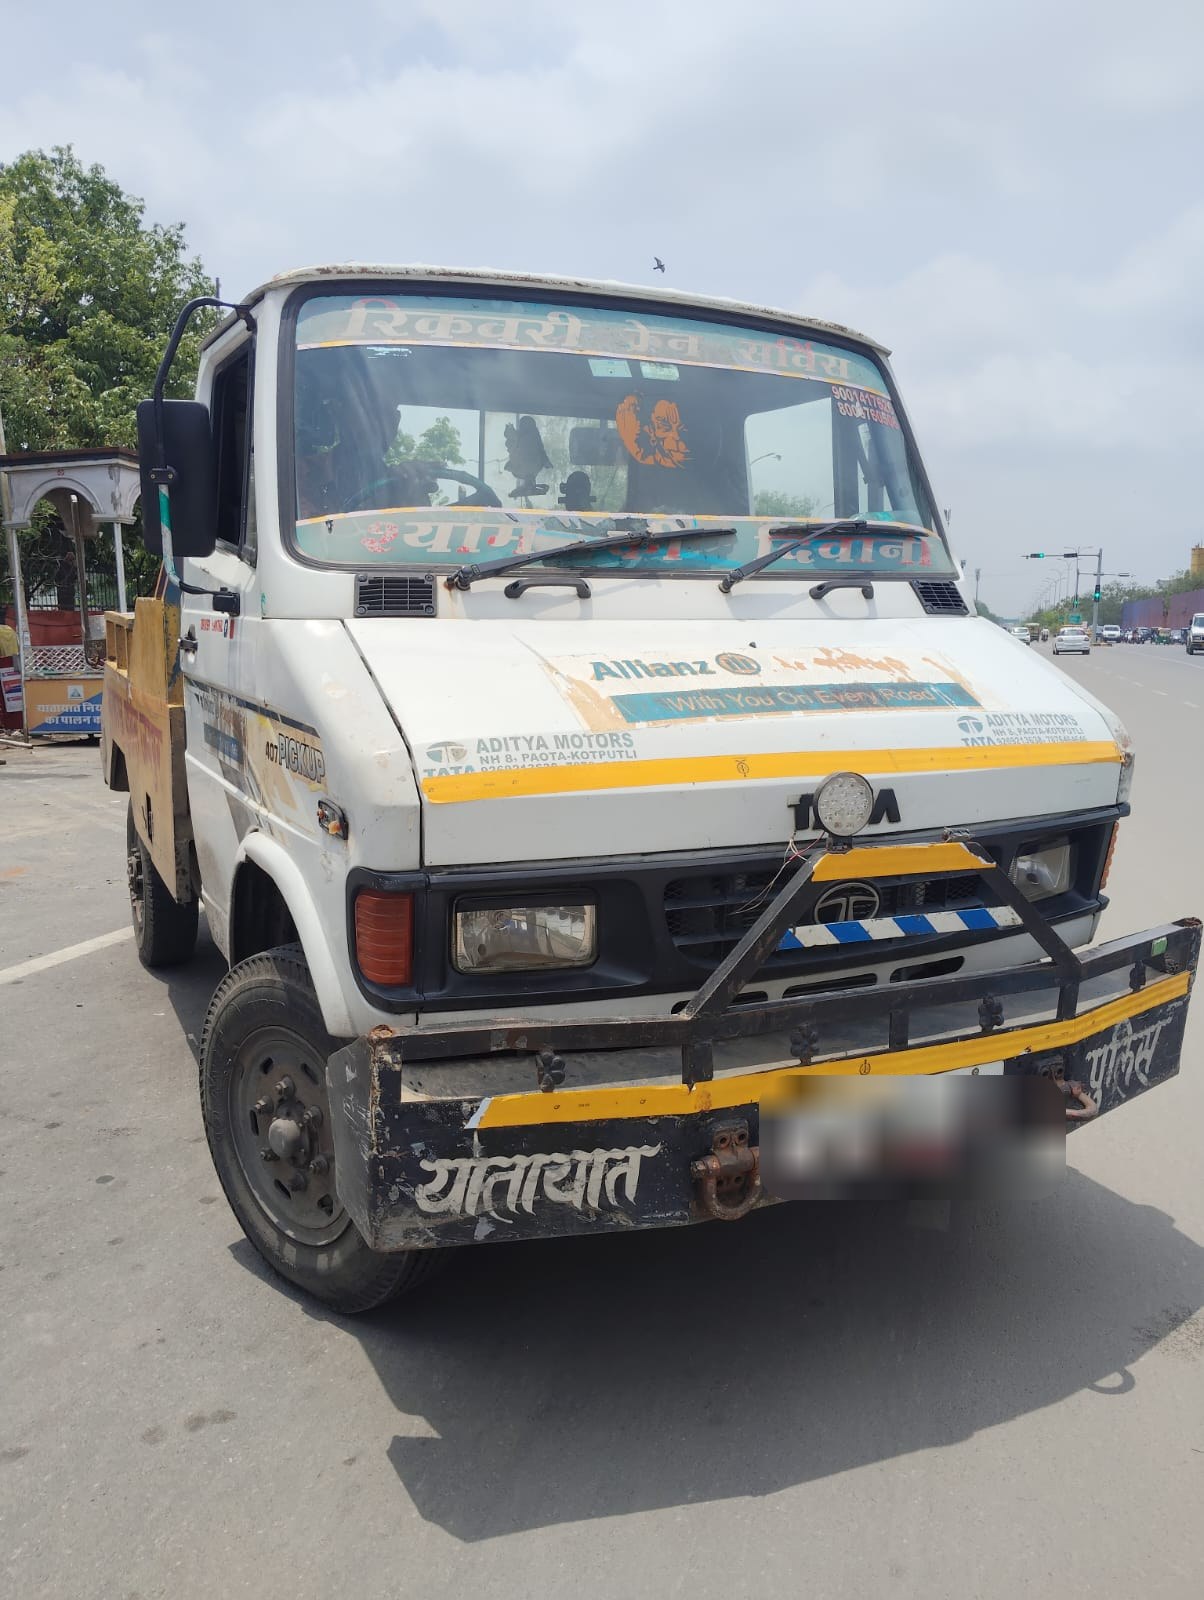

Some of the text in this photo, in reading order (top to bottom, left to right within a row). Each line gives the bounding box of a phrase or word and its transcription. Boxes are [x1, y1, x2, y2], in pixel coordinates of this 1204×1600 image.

[342, 298, 590, 347] रिकवरी
[590, 659, 716, 681] Allianz
[667, 687, 938, 713] With You On Every Road
[985, 713, 1078, 728] ADITYA MOTORS
[992, 728, 1006, 737] NH
[476, 732, 634, 754] ADITYA MOTORS
[265, 733, 325, 784] 407 PICKUP
[479, 754, 500, 765] NH
[505, 752, 518, 764] 8,
[522, 750, 637, 762] PAOTA-KOTPUTLI
[787, 788, 901, 831] TA
[415, 1142, 662, 1223] यातायात
